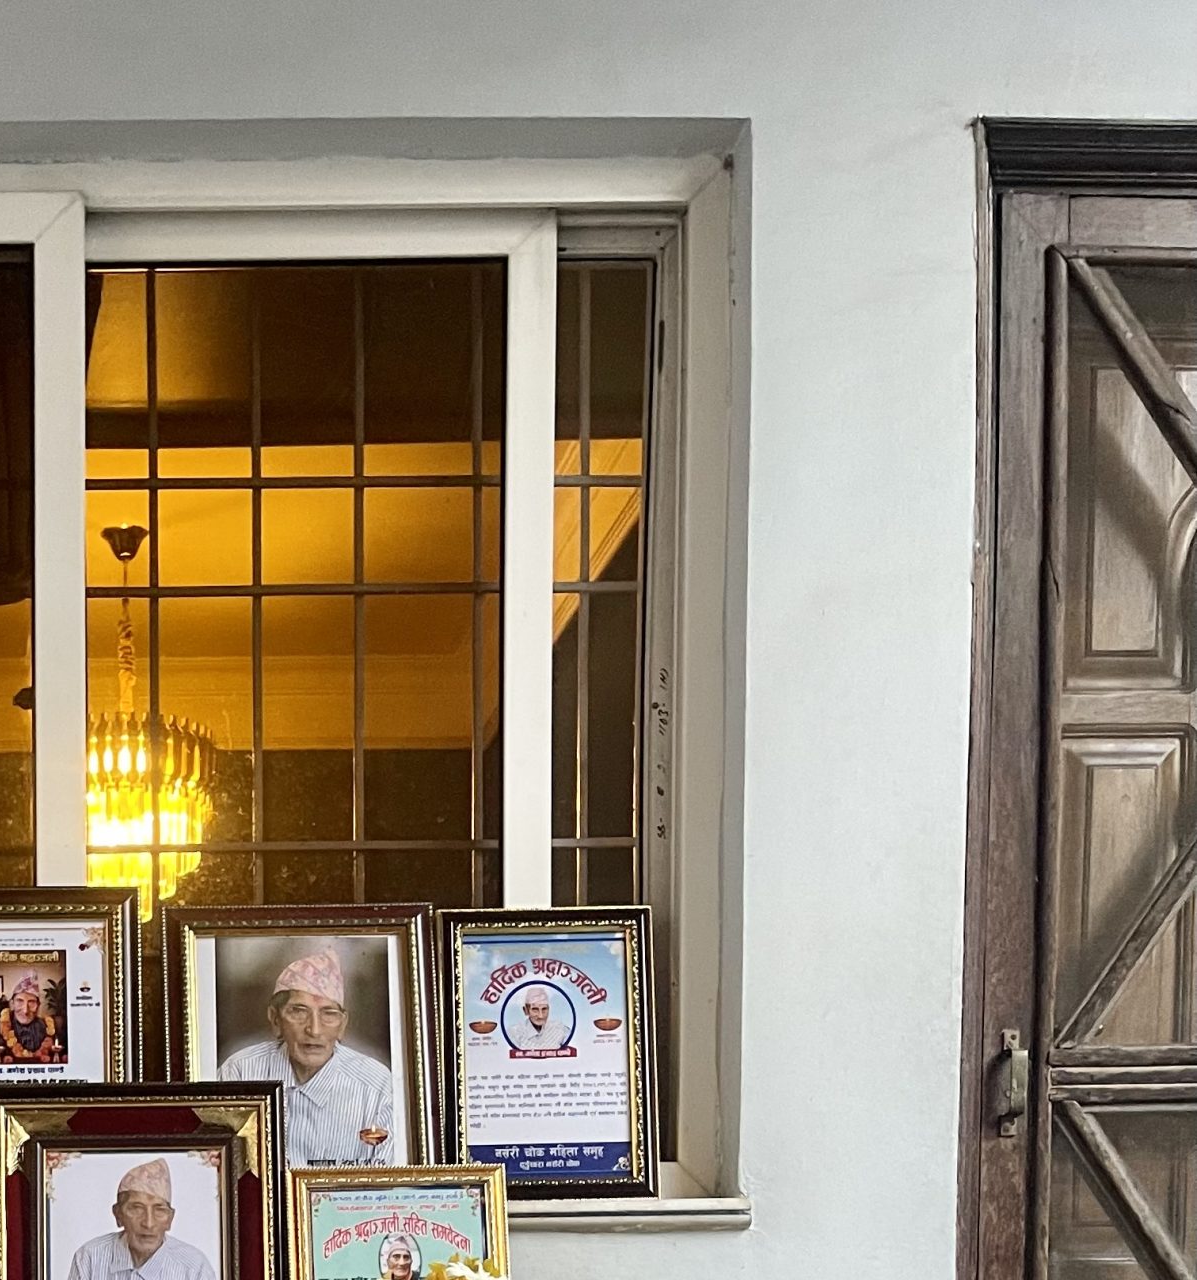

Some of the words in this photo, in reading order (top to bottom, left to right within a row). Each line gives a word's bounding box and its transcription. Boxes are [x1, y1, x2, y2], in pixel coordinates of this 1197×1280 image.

[480, 960, 527, 1005] हार्दिक
[524, 1146, 545, 1158] चोक
[549, 1144, 578, 1158] महिला
[322, 1228, 352, 1259] हार्दिक
[402, 1212, 428, 1236] सहित
[431, 1222, 472, 1254] समवेदना
